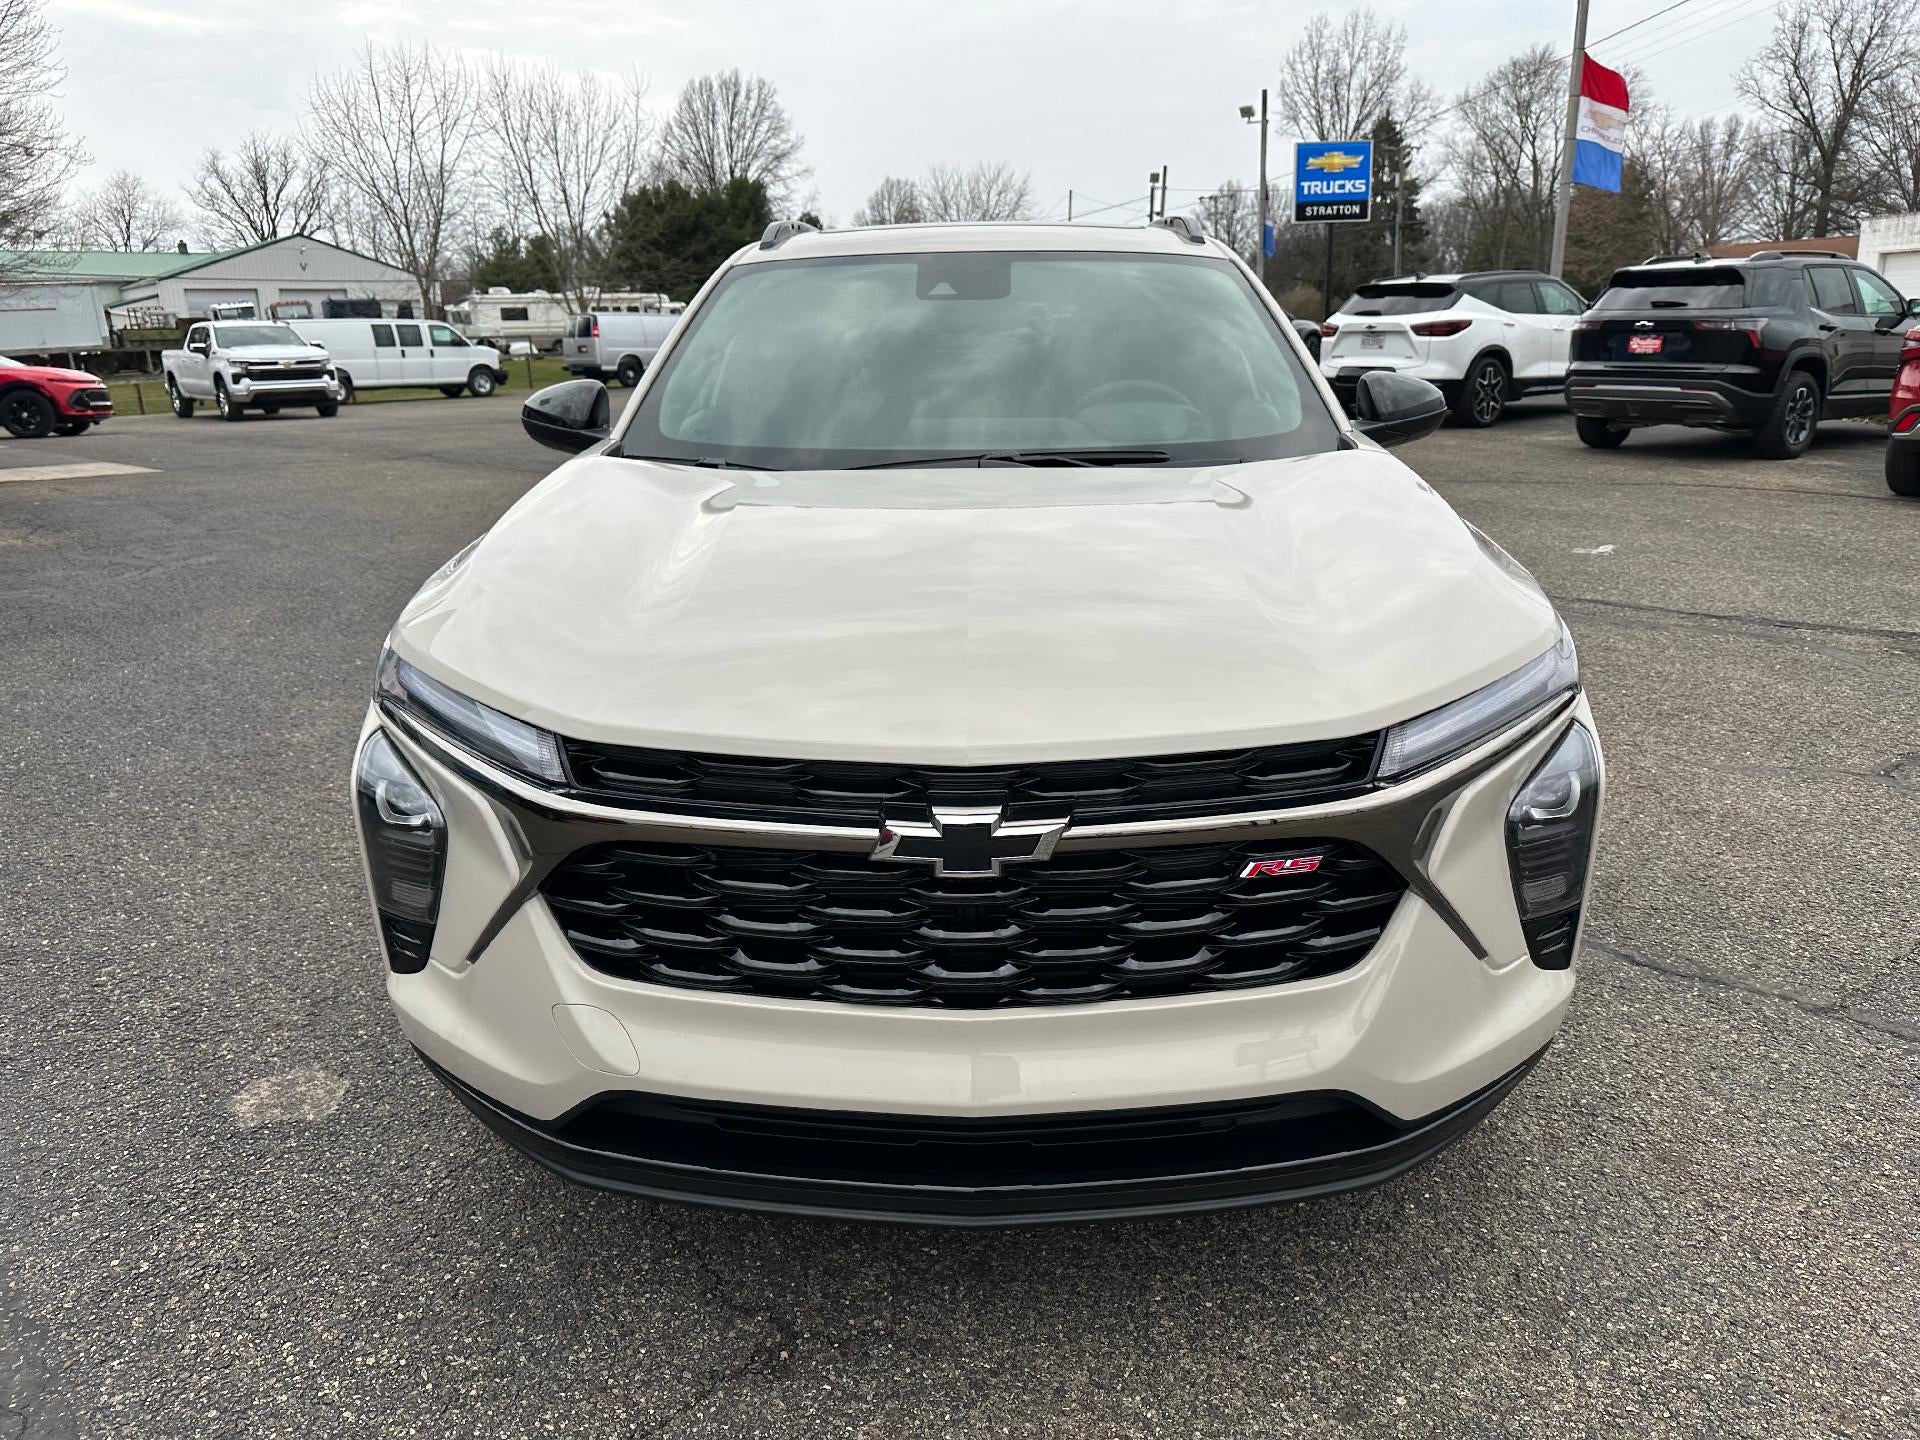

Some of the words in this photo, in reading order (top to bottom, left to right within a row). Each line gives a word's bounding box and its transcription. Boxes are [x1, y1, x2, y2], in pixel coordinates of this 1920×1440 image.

[1300, 180, 1366, 195] TRUCKS
[1305, 205, 1360, 216] STRATTON
[1239, 855, 1324, 879] RS
